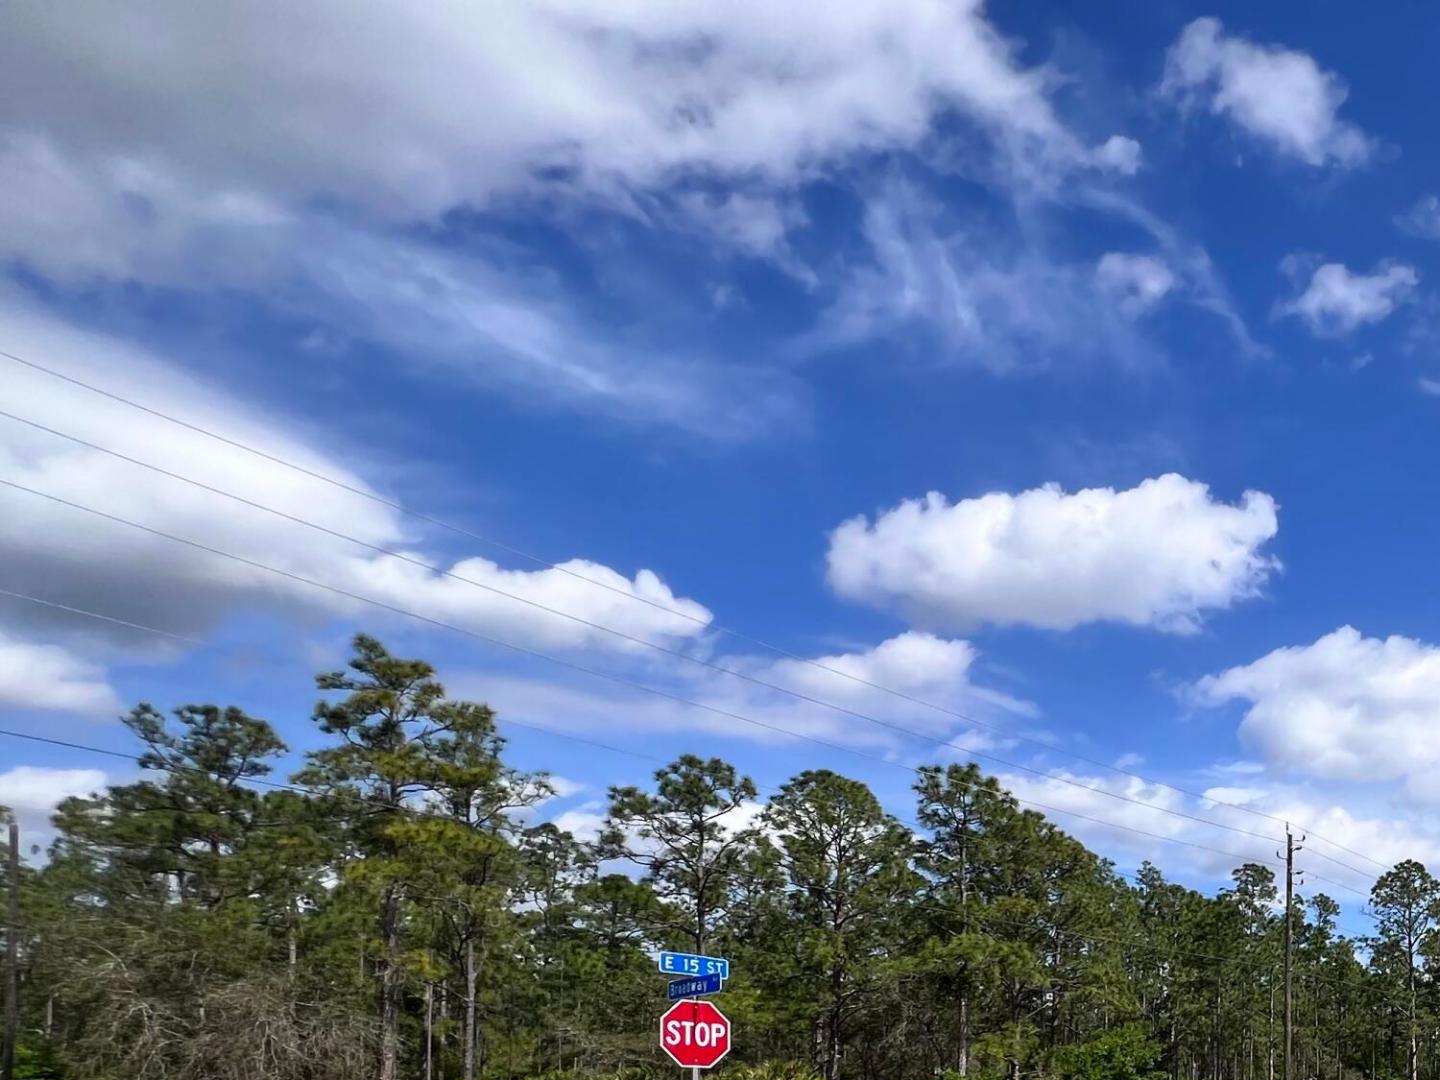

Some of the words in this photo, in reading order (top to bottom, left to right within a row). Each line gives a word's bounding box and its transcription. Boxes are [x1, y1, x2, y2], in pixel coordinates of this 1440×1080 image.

[665, 956, 674, 970] E
[684, 958, 699, 973] 15
[707, 961, 723, 974] ST
[665, 1020, 726, 1047] STOP
